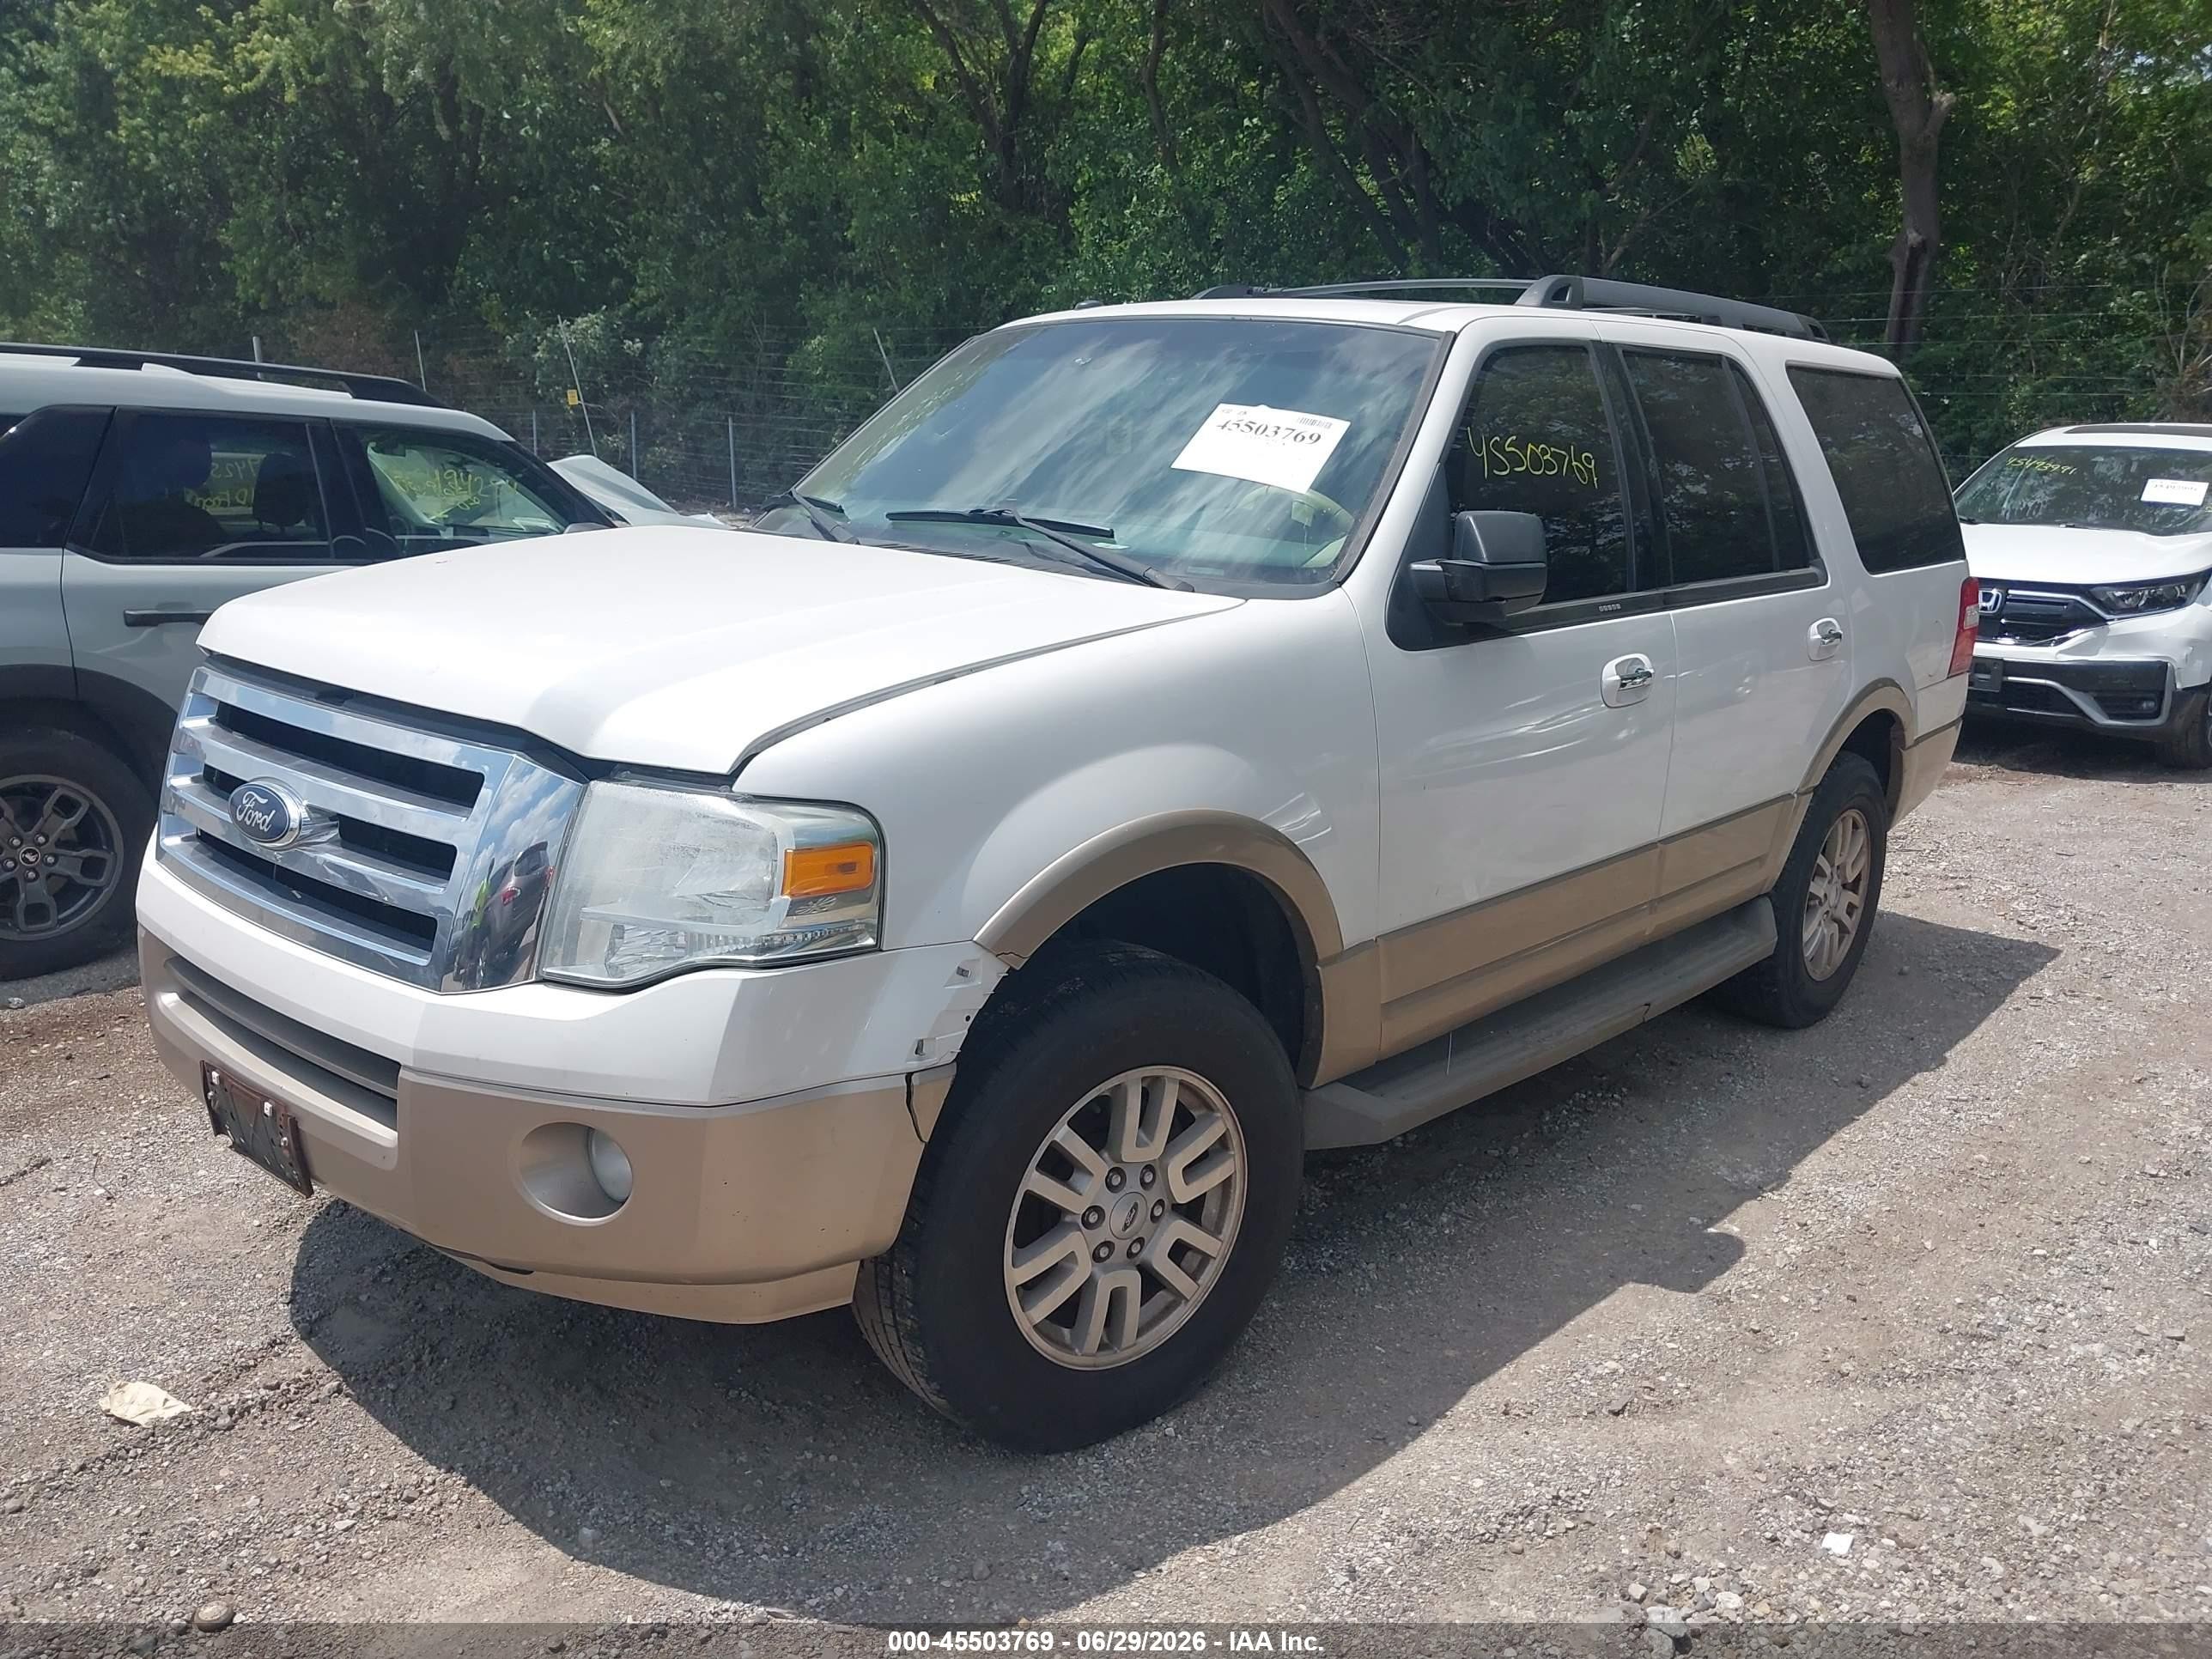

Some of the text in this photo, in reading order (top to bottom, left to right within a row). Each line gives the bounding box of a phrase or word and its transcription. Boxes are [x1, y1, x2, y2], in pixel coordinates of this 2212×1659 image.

[1216, 419, 1322, 445] 45503769
[1467, 426, 1599, 489] 45503769
[235, 790, 276, 833] Ford
